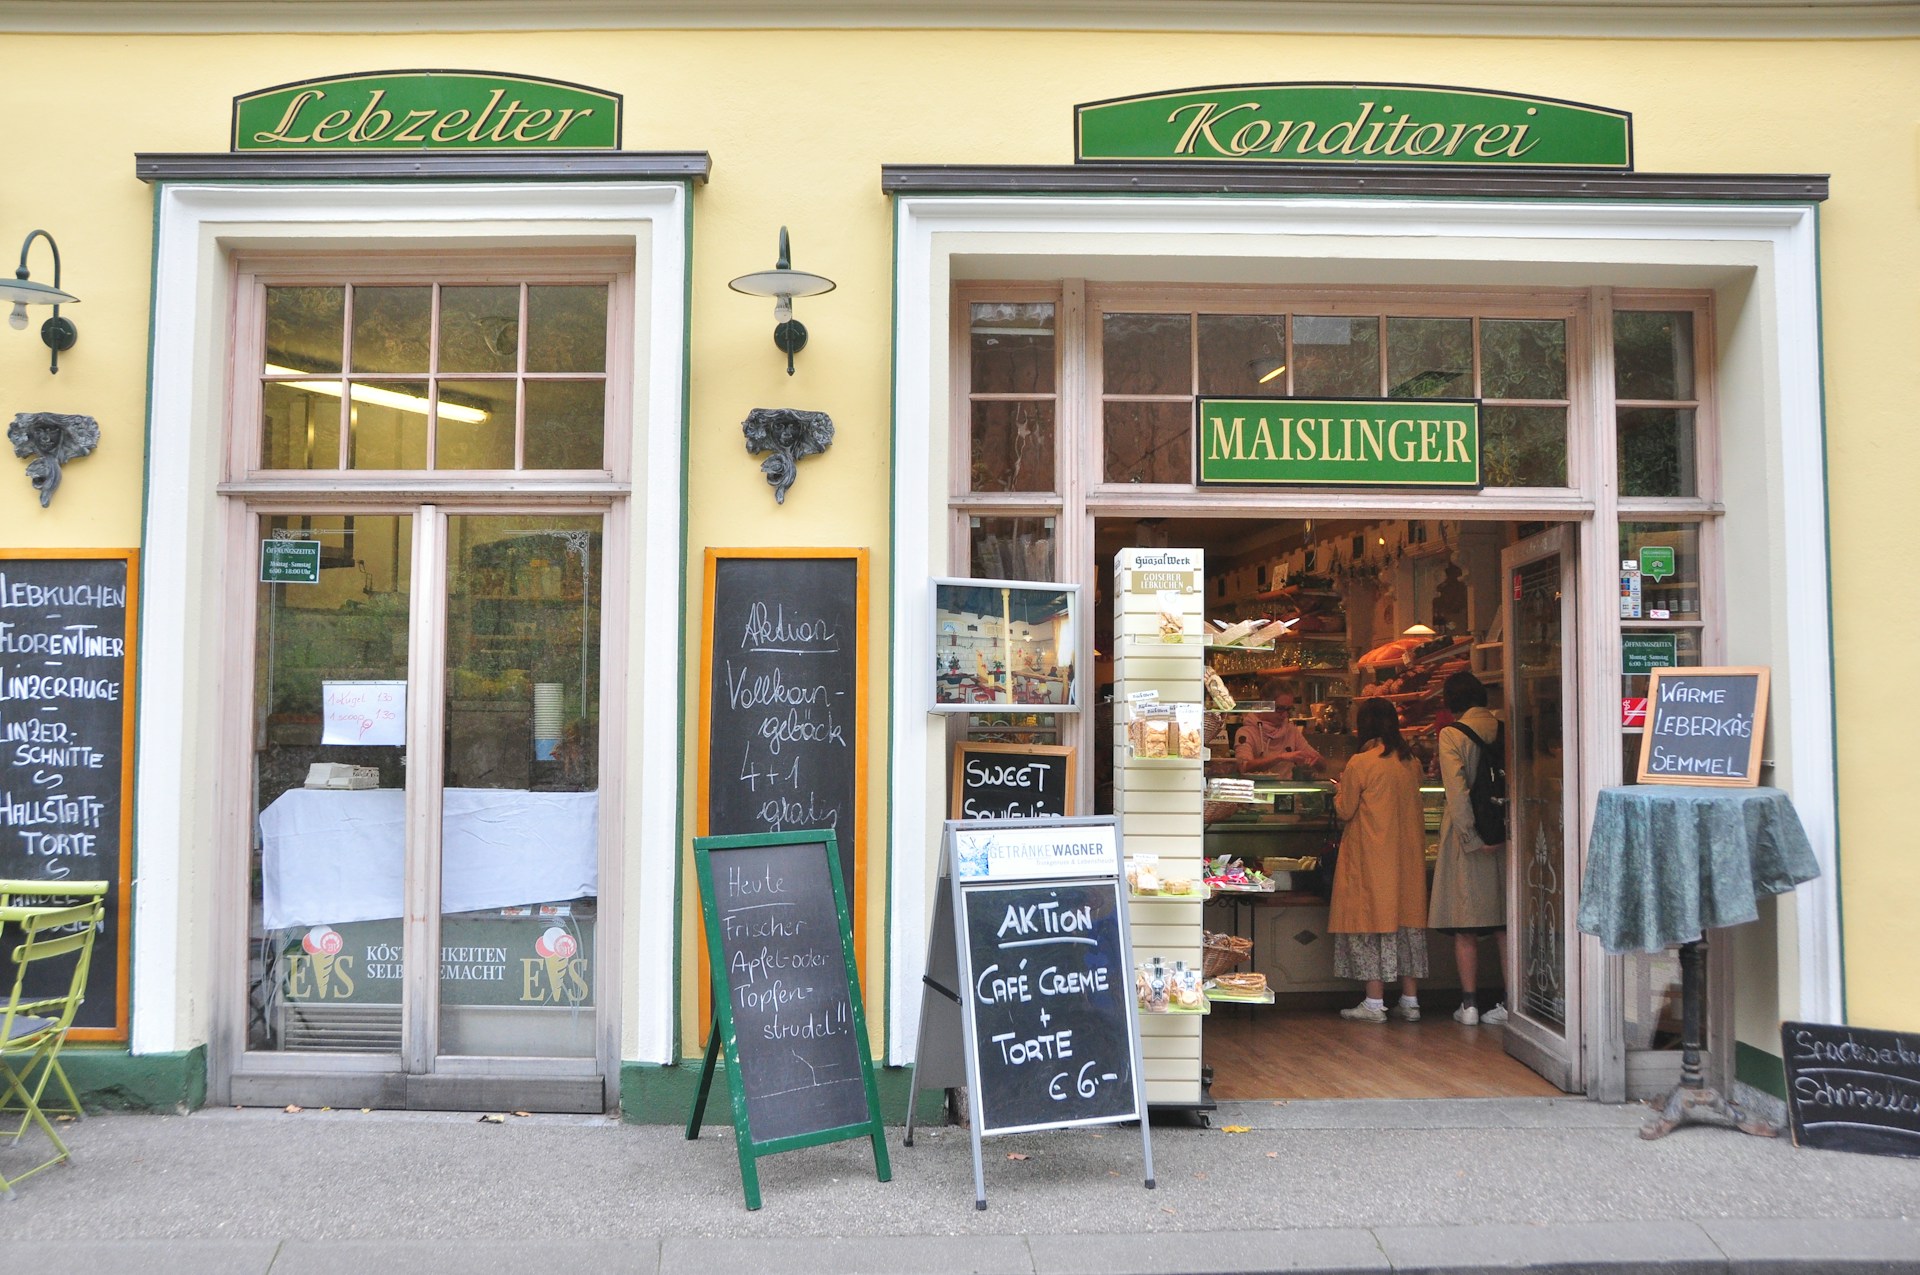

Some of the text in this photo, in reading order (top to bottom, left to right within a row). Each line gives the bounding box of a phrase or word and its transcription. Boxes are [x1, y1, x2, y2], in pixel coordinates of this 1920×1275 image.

[254, 87, 593, 144] Lebzelter
[1167, 102, 1541, 158] Konditorei
[1208, 416, 1471, 463] MAISLINGER
[0, 572, 125, 608] LEBKUCHEN
[0, 621, 124, 657] FLORENTINER
[741, 601, 835, 648] Aktion
[0, 666, 119, 700] LINZERAUGE
[12, 744, 104, 768] SCHNITTE
[740, 740, 800, 791] 4 + 1
[1652, 746, 1743, 776] SEMMEL
[966, 759, 1050, 792] SWEET
[0, 791, 104, 828] HALLSTATT
[19, 831, 96, 856] TORTE
[729, 864, 787, 897] Heute
[723, 915, 807, 941] Frischer
[367, 964, 506, 980] SELBEMACHT
[977, 958, 1109, 1004] CAFÉ CREME
[1040, 1008, 1050, 1027] +
[992, 1030, 1073, 1065] TORTE
